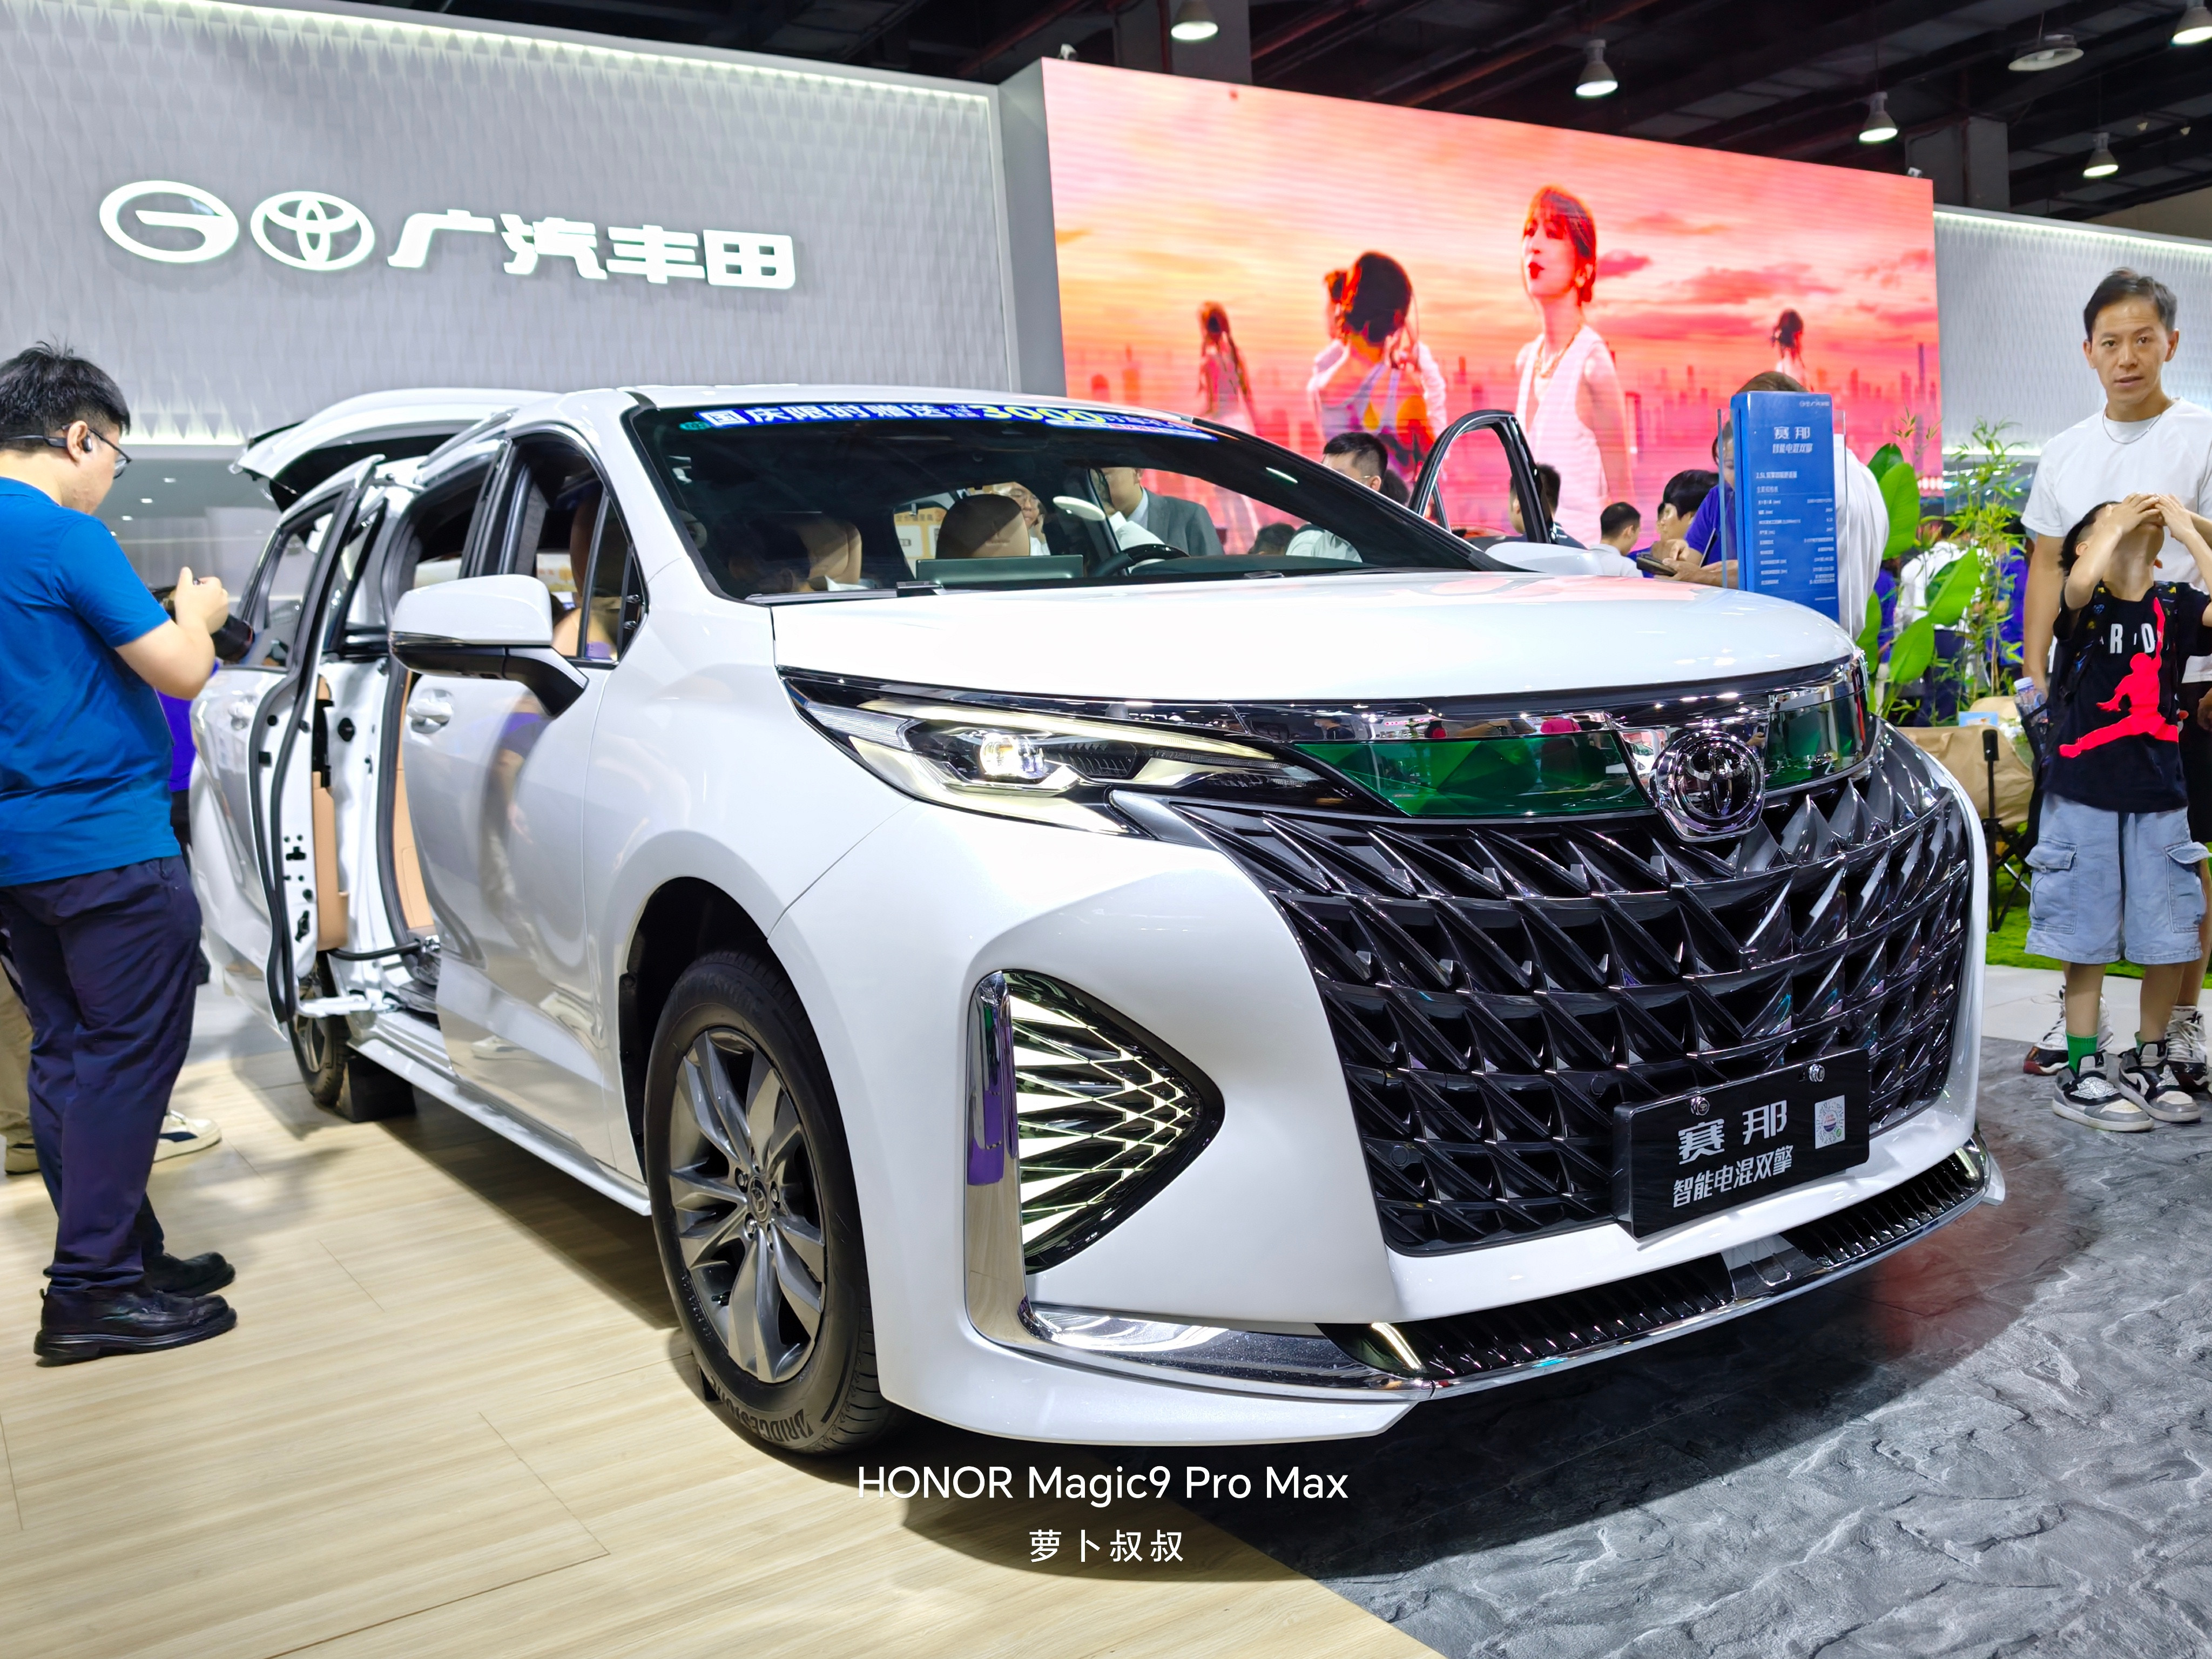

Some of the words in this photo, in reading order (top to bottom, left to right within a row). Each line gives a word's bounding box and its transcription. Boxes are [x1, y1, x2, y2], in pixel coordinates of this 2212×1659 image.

[387, 209, 796, 289] 广汽丰田
[1673, 1144, 1793, 1208] 智能电混双擎
